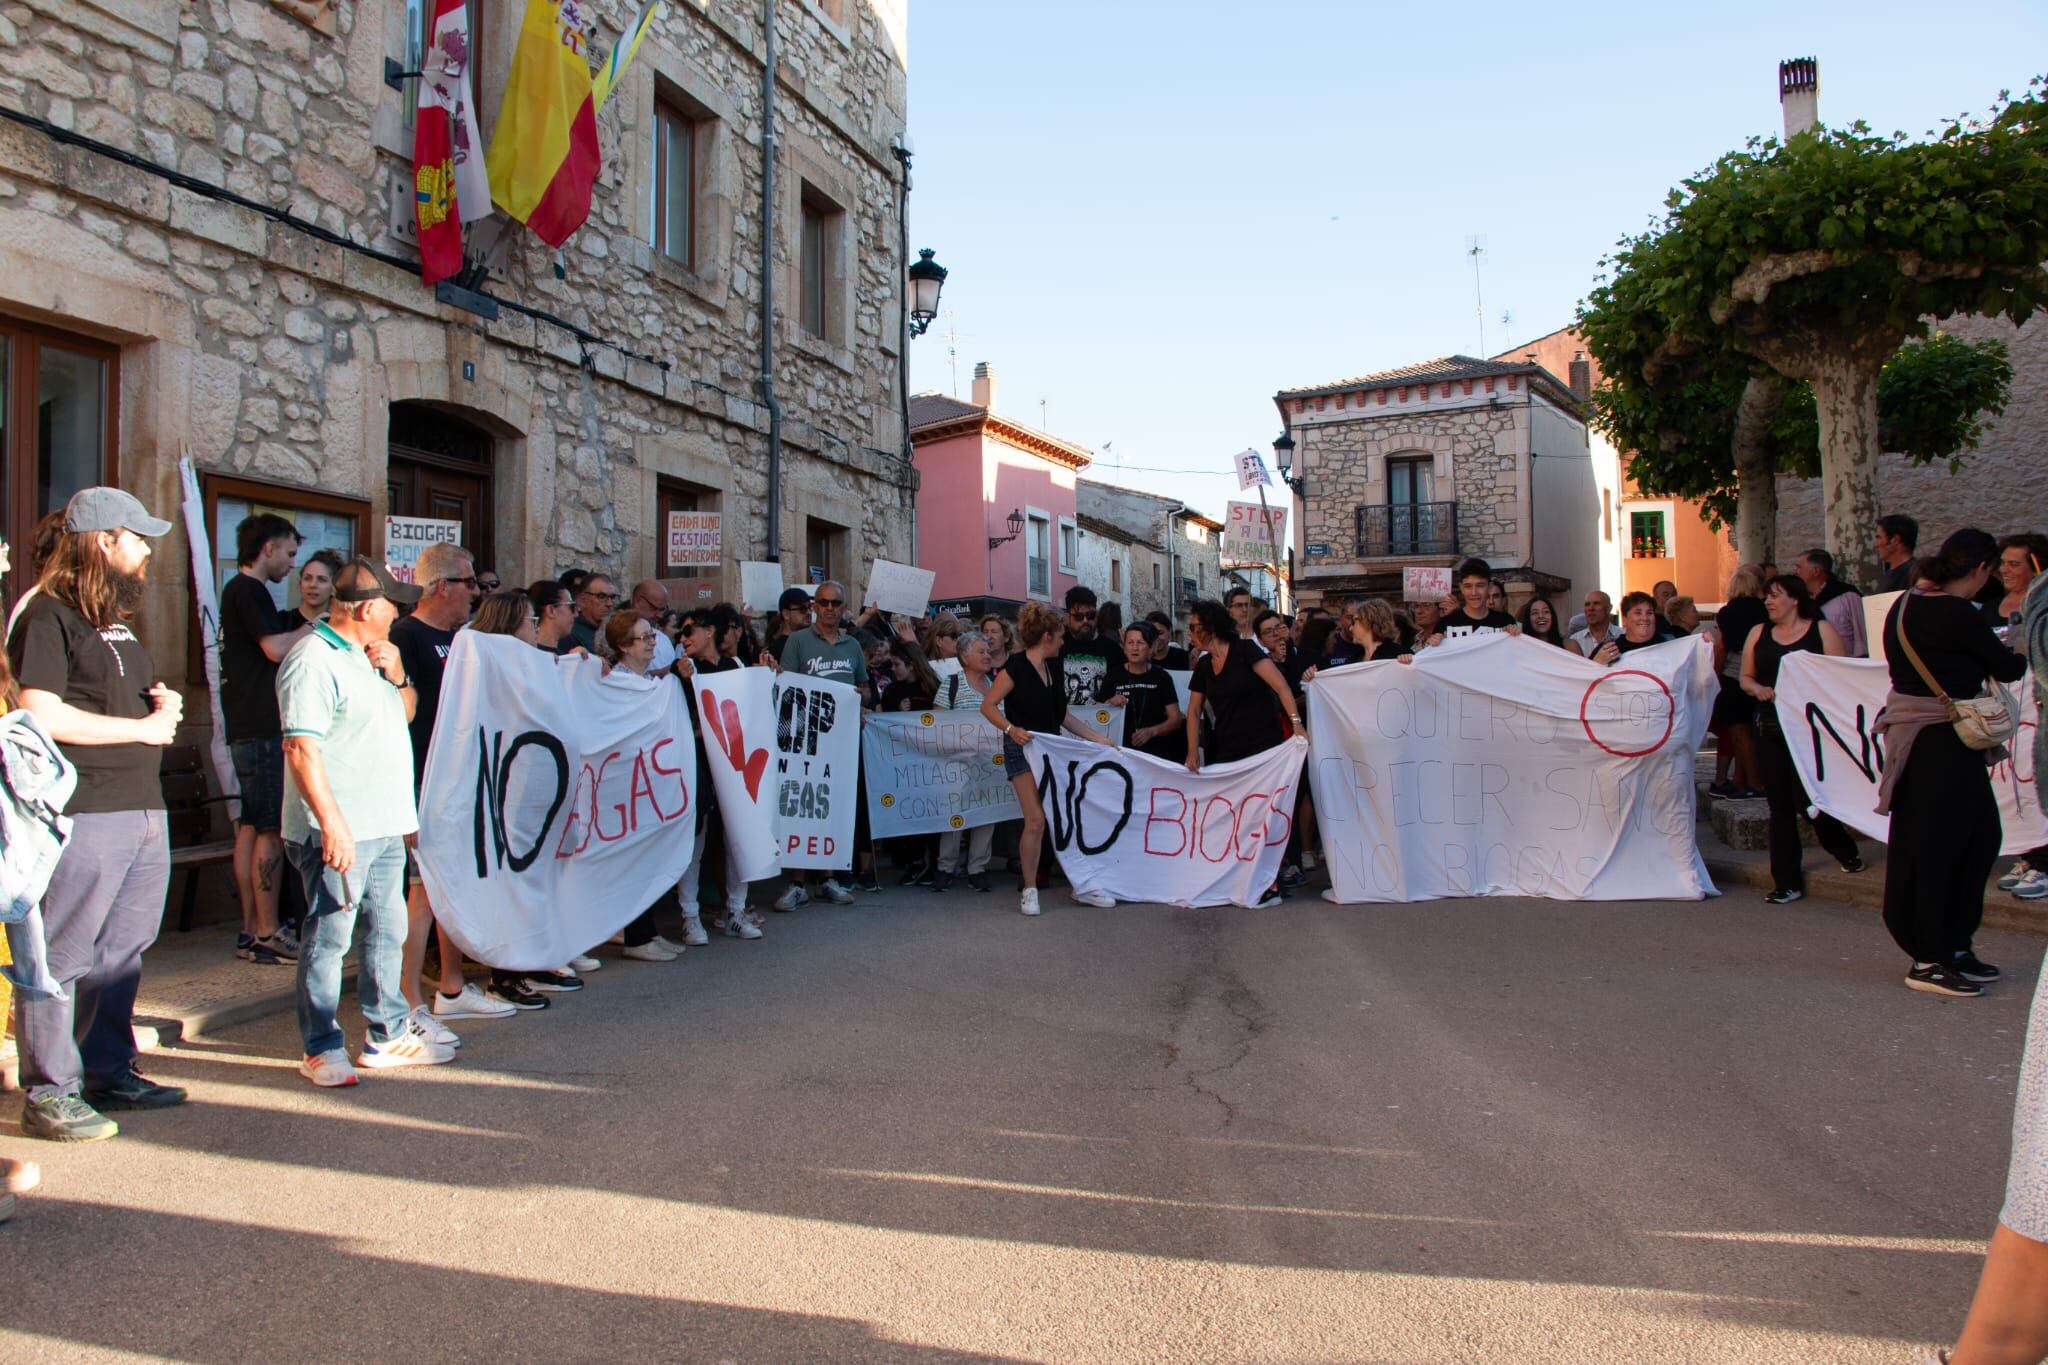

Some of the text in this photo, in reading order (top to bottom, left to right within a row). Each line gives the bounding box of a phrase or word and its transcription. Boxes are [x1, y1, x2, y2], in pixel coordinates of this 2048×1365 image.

[466, 365, 471, 377] 1
[701, 516, 720, 529] UNO
[1232, 506, 1283, 525] STOP
[391, 523, 456, 542] BIOGAS
[672, 532, 721, 546] GESTIONE
[1258, 527, 1273, 540] L
[391, 544, 424, 562] BON
[939, 603, 971, 614] CxaBank
[807, 656, 831, 675] New
[1376, 687, 1560, 744] QUIERO
[1594, 690, 1664, 728] STOP
[1805, 702, 1887, 784] N
[474, 726, 569, 878] NO
[779, 779, 830, 820] GAS
[1038, 753, 1134, 855] NO
[1317, 757, 1692, 836] CRECER SANO
[787, 834, 836, 856] PED
[1334, 840, 1599, 898] NO BIOGAS
